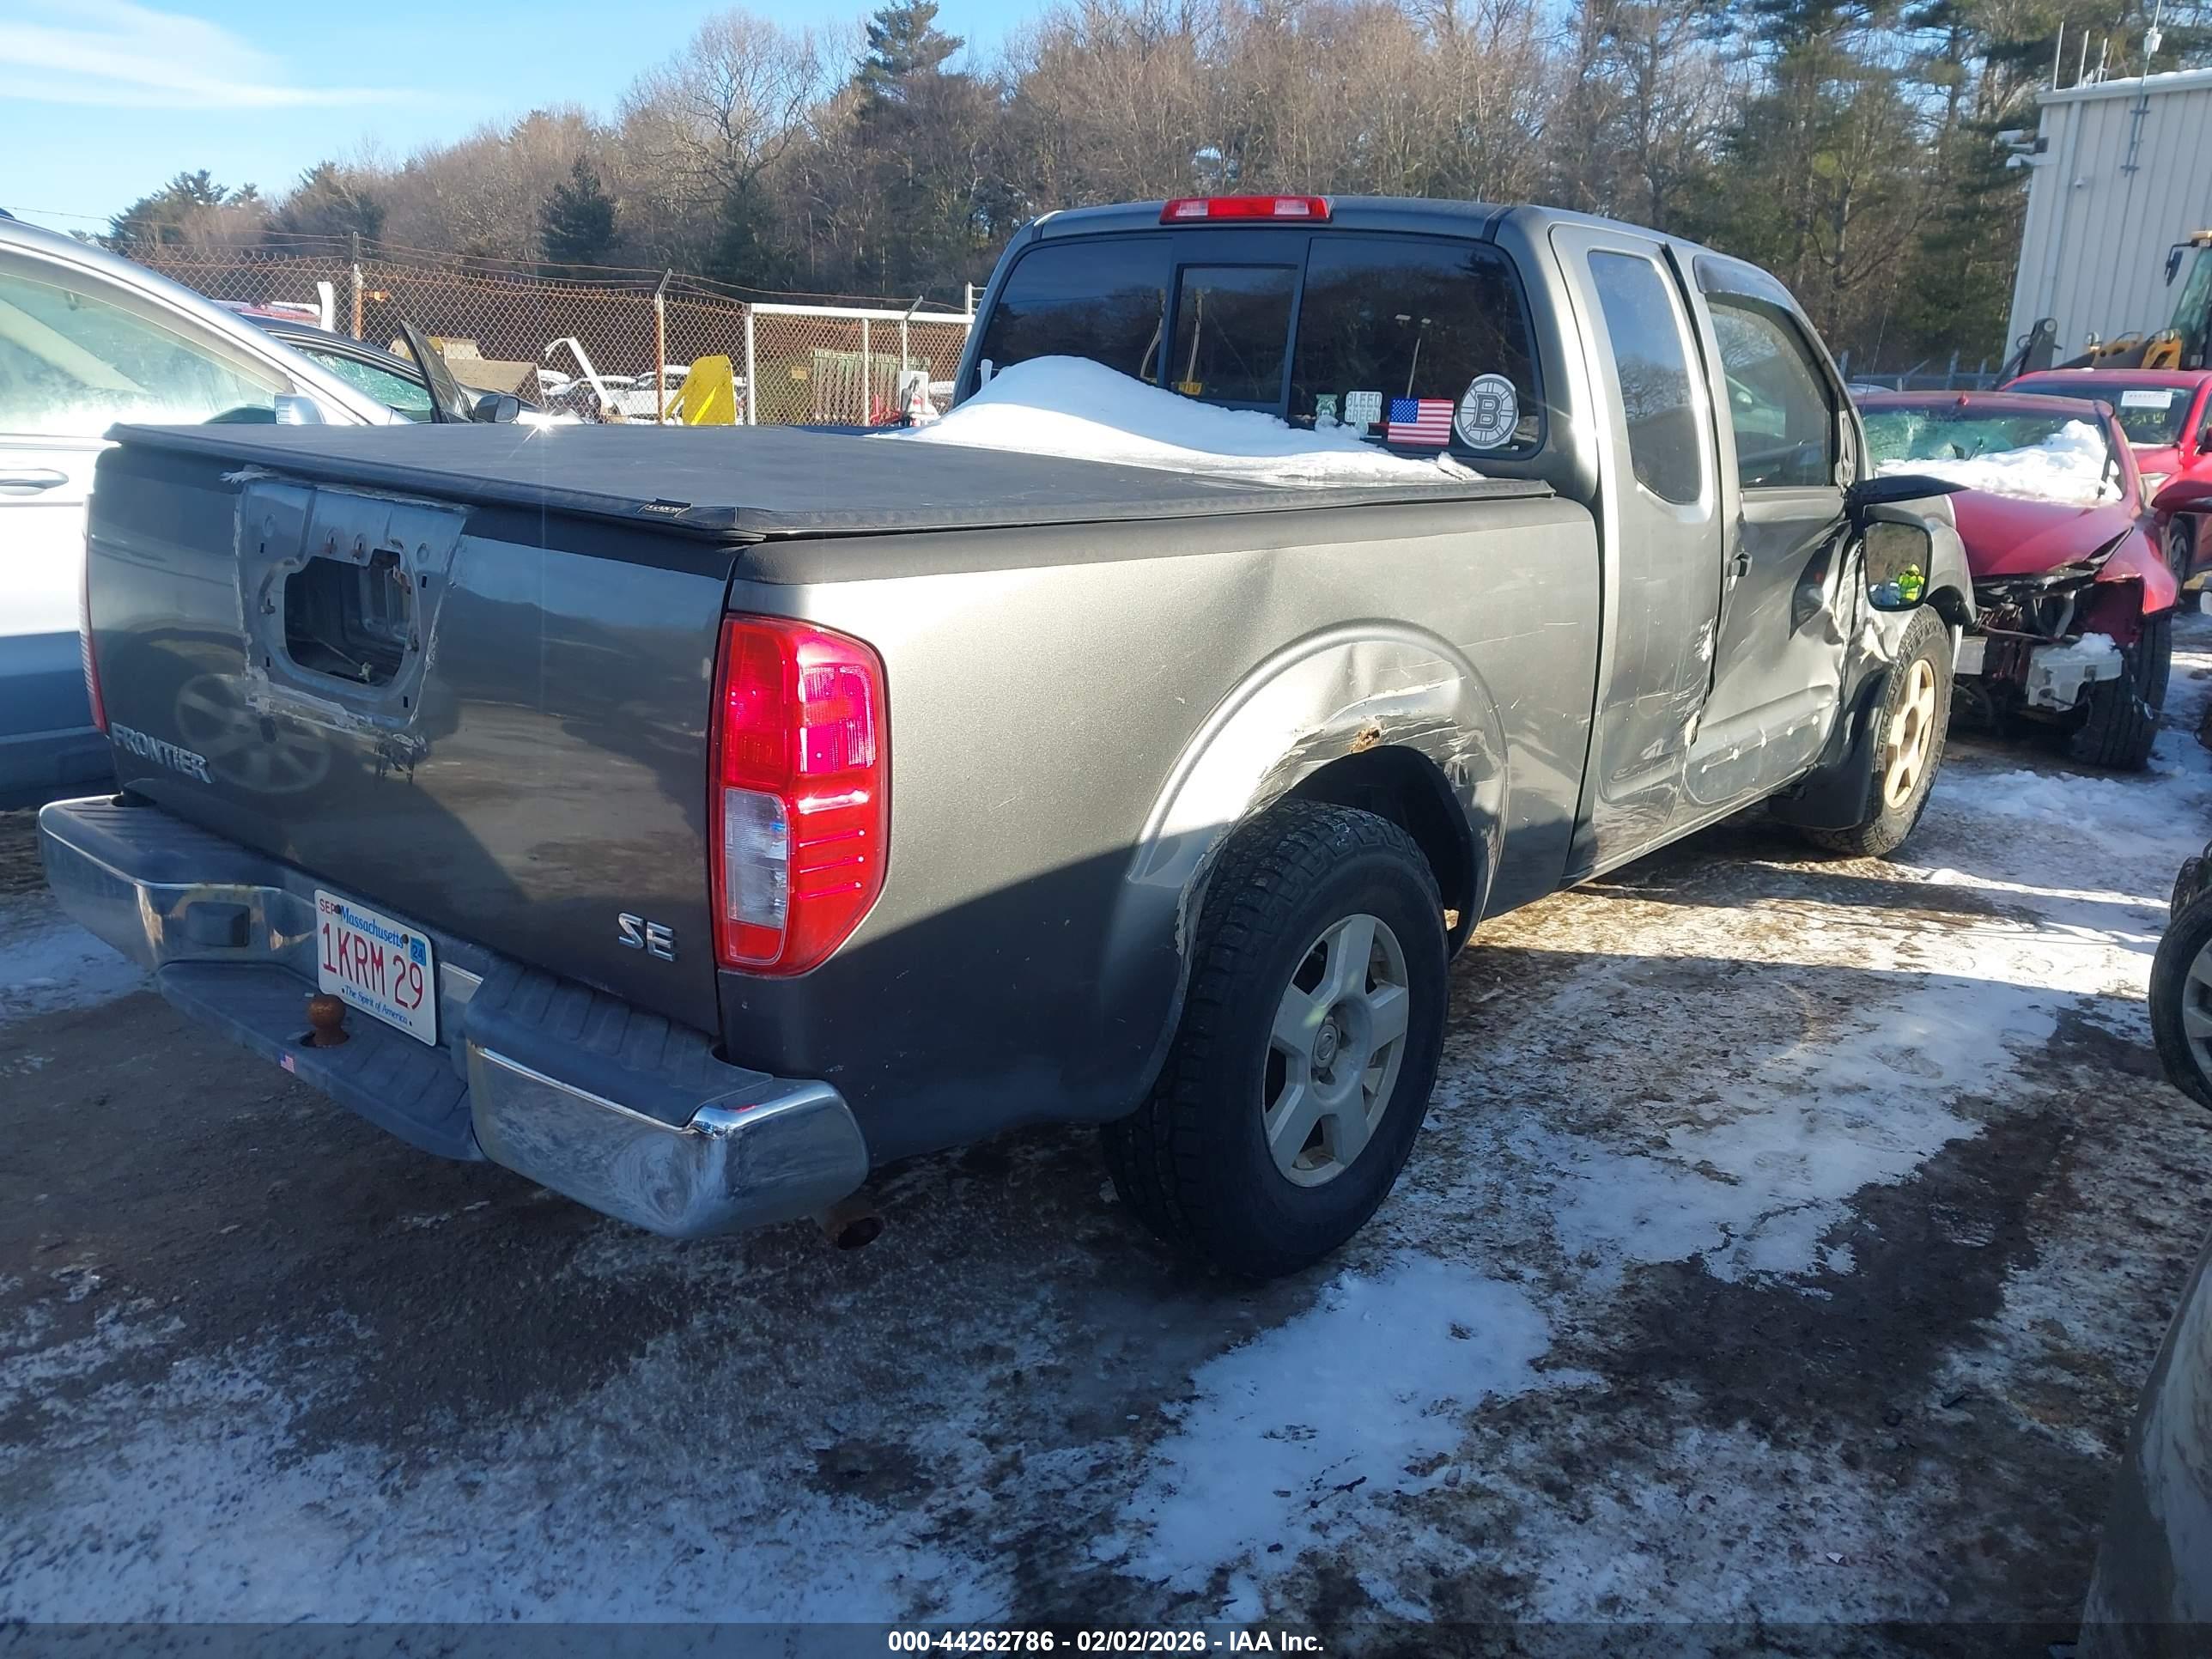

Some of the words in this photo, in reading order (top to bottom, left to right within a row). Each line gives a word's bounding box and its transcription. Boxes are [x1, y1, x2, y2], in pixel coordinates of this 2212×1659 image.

[1346, 392, 1381, 407] BLEED
[1346, 409, 1380, 422] GREEN
[111, 722, 212, 783] FRONTIER
[319, 898, 337, 915] SEP
[341, 905, 404, 949] Massachusetts
[412, 945, 424, 960] 24
[618, 913, 673, 962] SE
[323, 922, 386, 996] 1KRM
[392, 955, 423, 1010] 29
[345, 985, 357, 999] The
[357, 991, 374, 1007] Spirit
[382, 1006, 408, 1026] America
